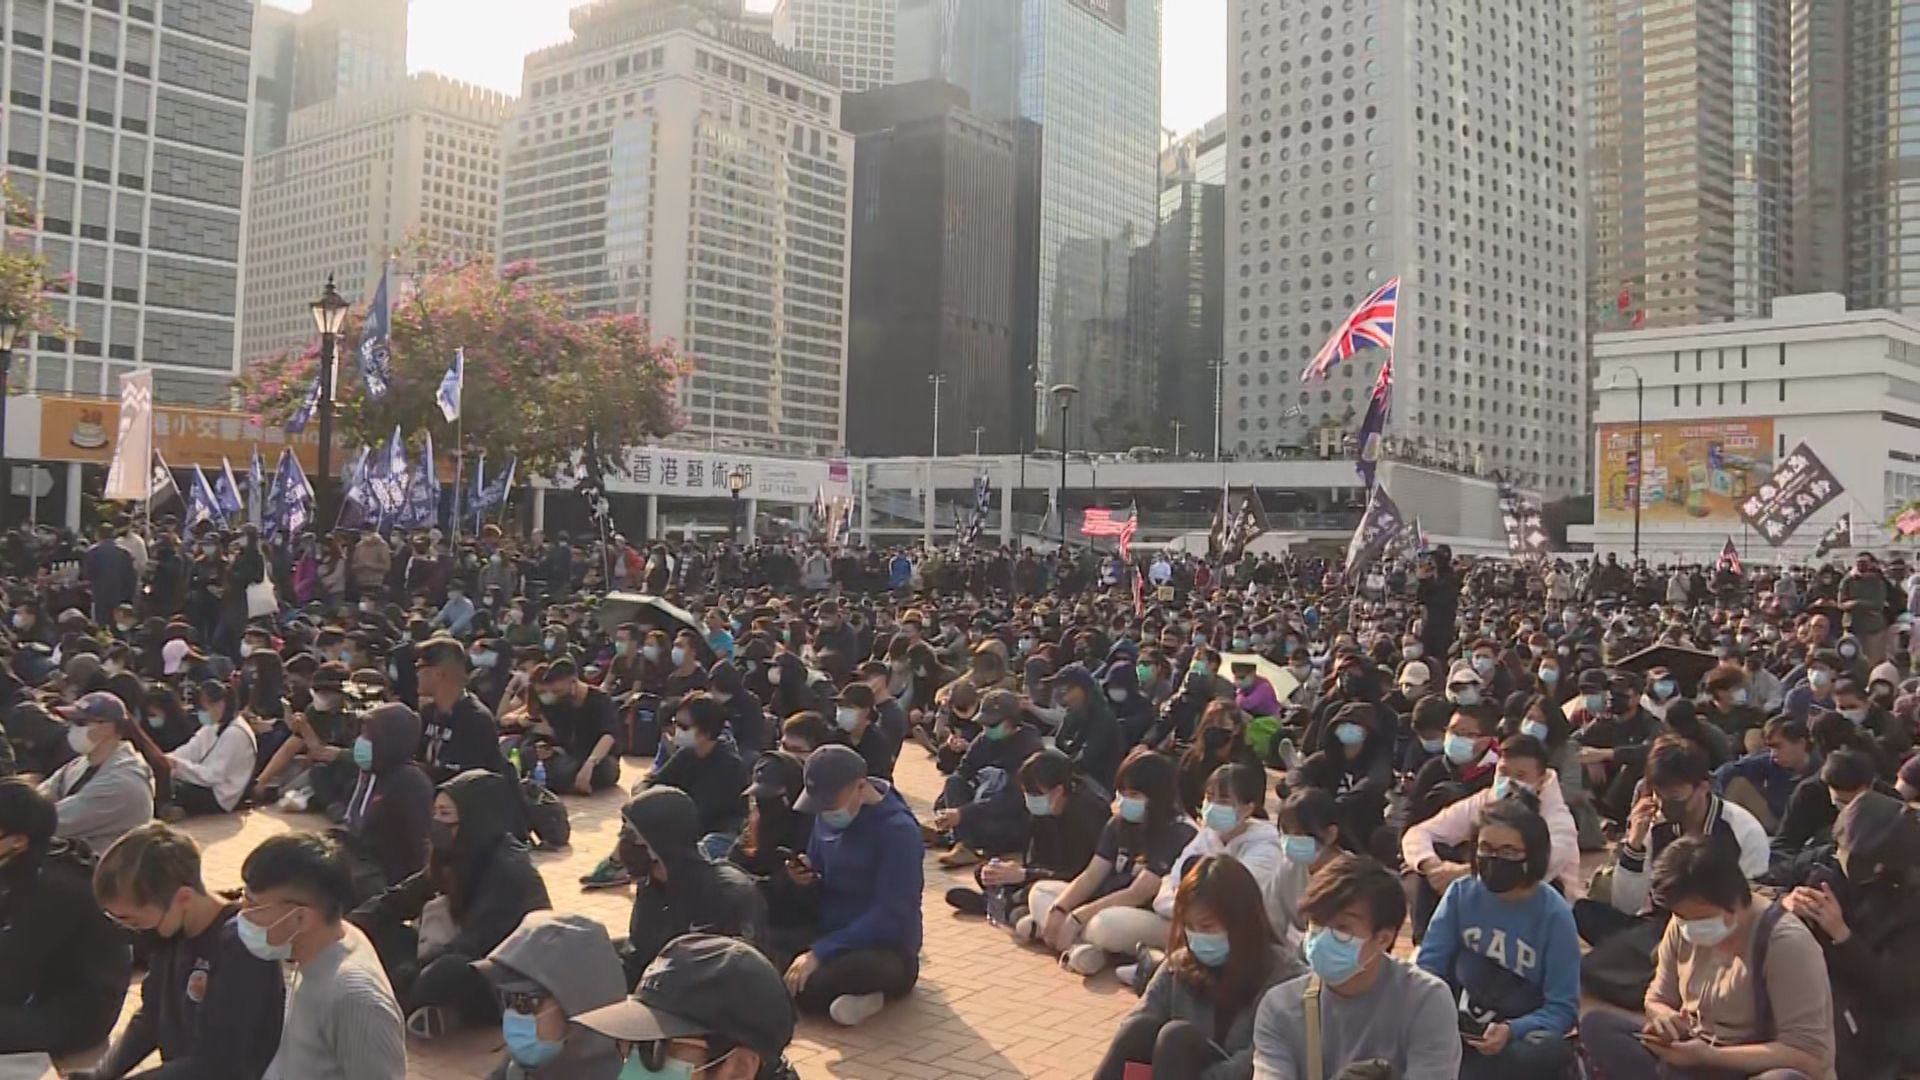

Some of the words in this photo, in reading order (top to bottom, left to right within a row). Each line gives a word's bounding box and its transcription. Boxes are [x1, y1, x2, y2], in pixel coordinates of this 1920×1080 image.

[633, 454, 753, 489] 香港藝術節
[1462, 926, 1537, 978] GAP
